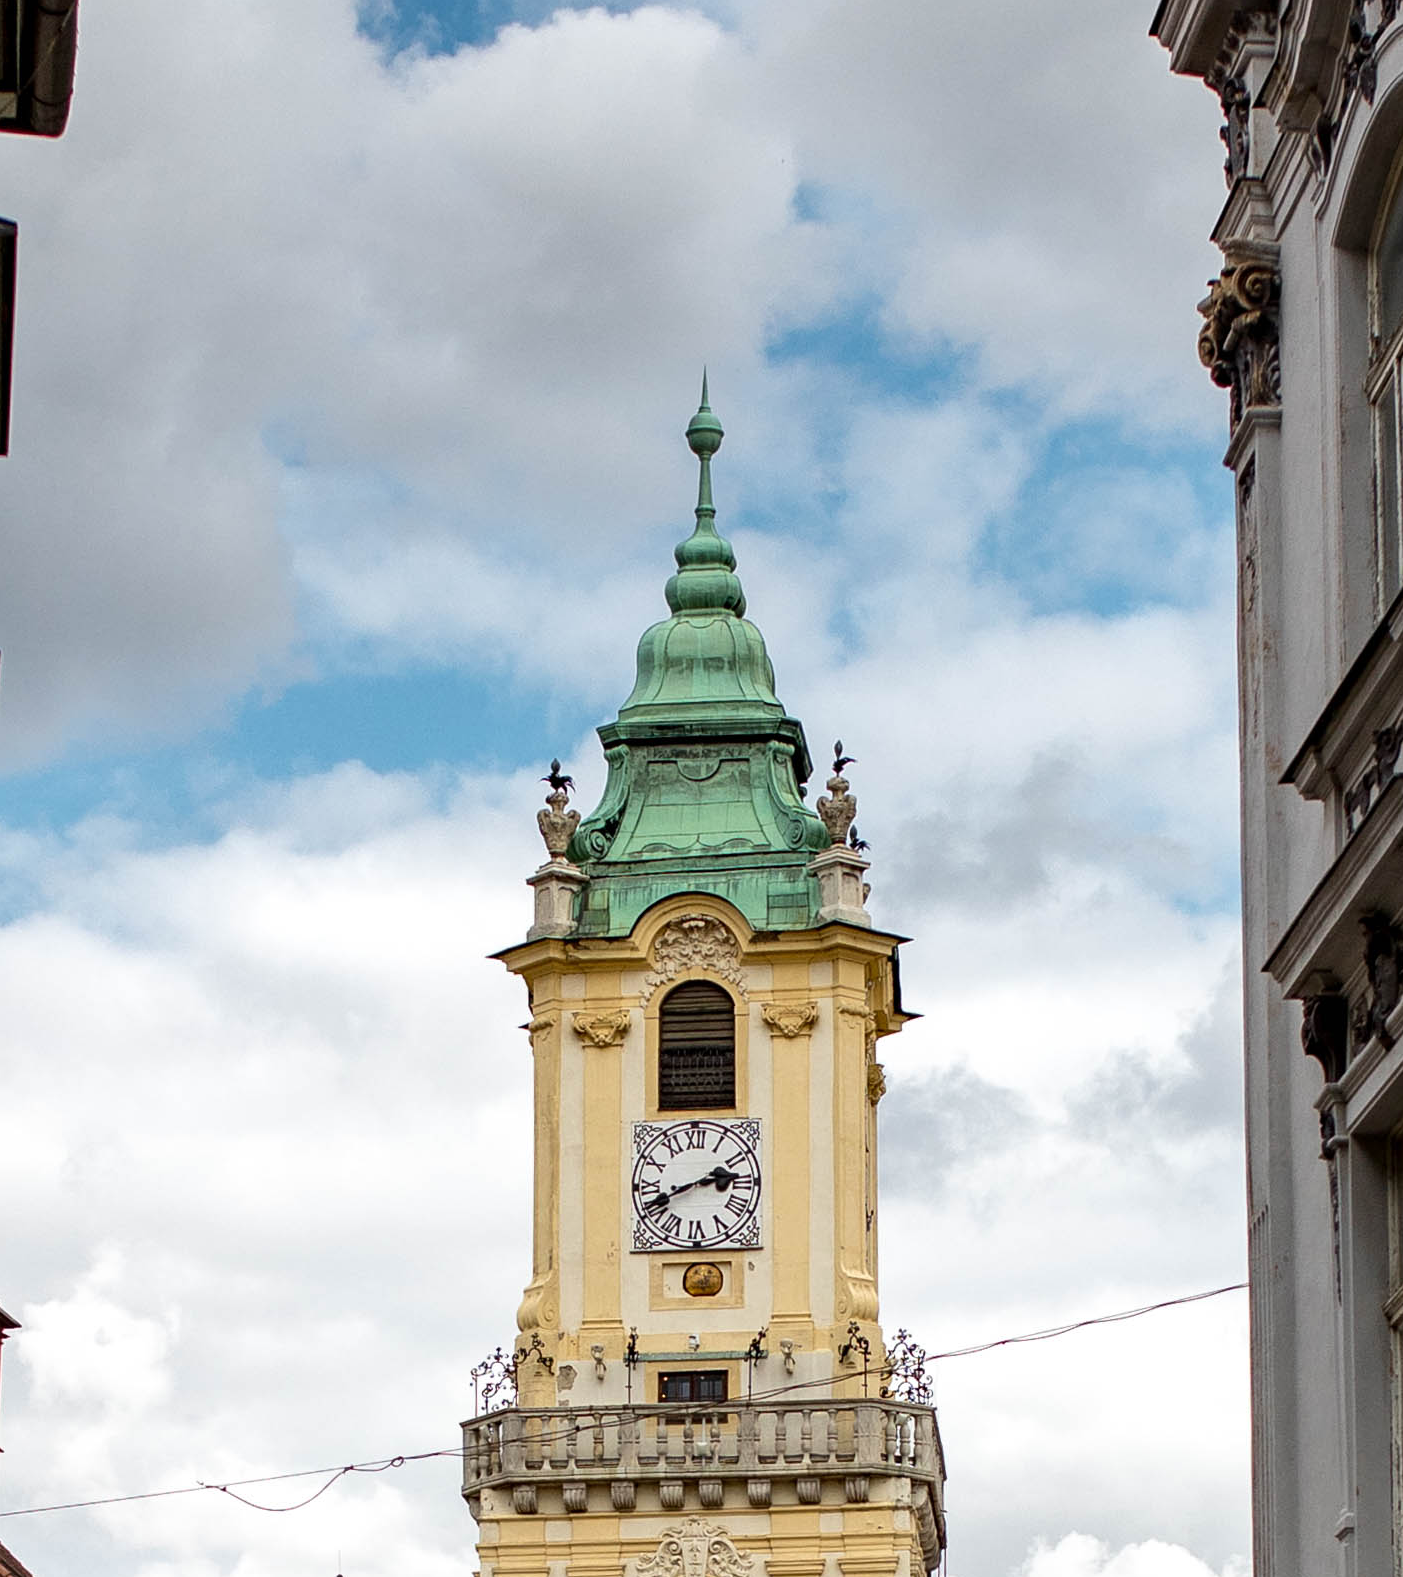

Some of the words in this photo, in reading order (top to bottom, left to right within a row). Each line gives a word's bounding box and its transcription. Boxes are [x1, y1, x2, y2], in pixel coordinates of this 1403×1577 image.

[661, 1134, 684, 1159] XI
[684, 1129, 706, 1150] XII
[712, 1135, 725, 1153] I
[645, 1155, 666, 1174] X
[725, 1151, 746, 1169] II
[641, 1179, 660, 1196] IX
[660, 1213, 682, 1237] VII
[688, 1220, 706, 1239] VI
[712, 1215, 729, 1234] V
